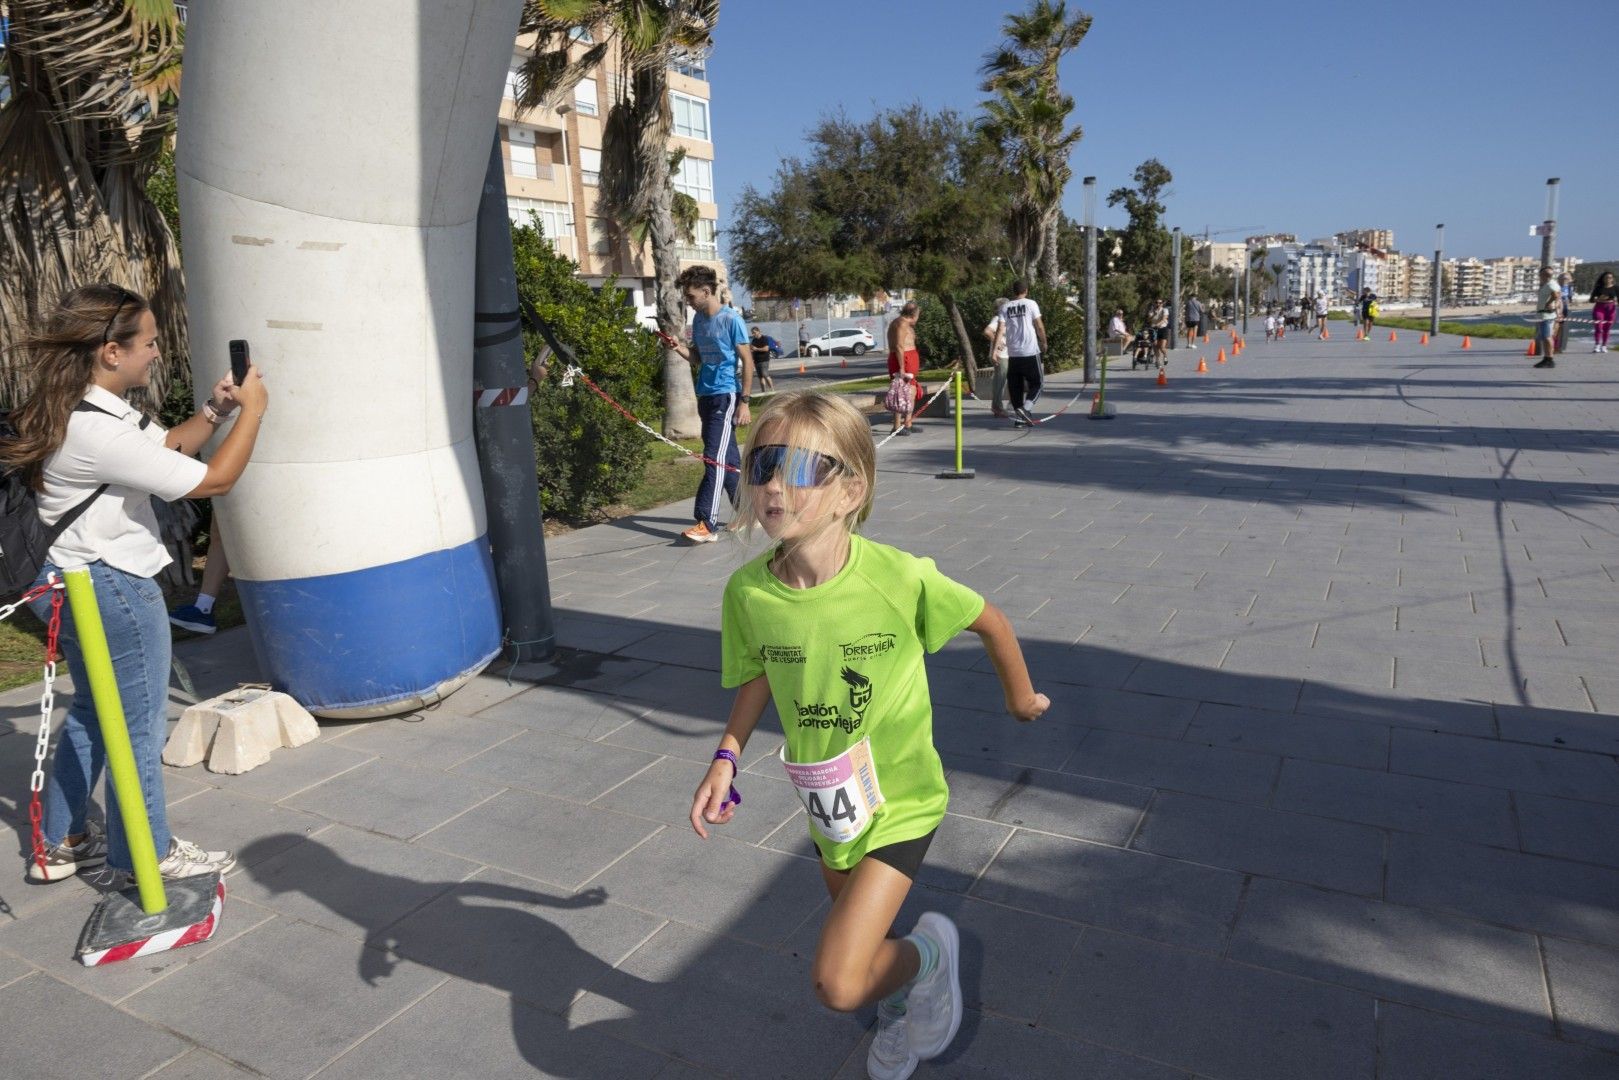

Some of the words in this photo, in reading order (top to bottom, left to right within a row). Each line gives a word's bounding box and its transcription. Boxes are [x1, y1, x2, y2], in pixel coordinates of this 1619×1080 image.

[767, 649, 801, 657] COMUNITAT
[838, 639, 895, 657] TORREVIEJA
[797, 786, 857, 829] 44
